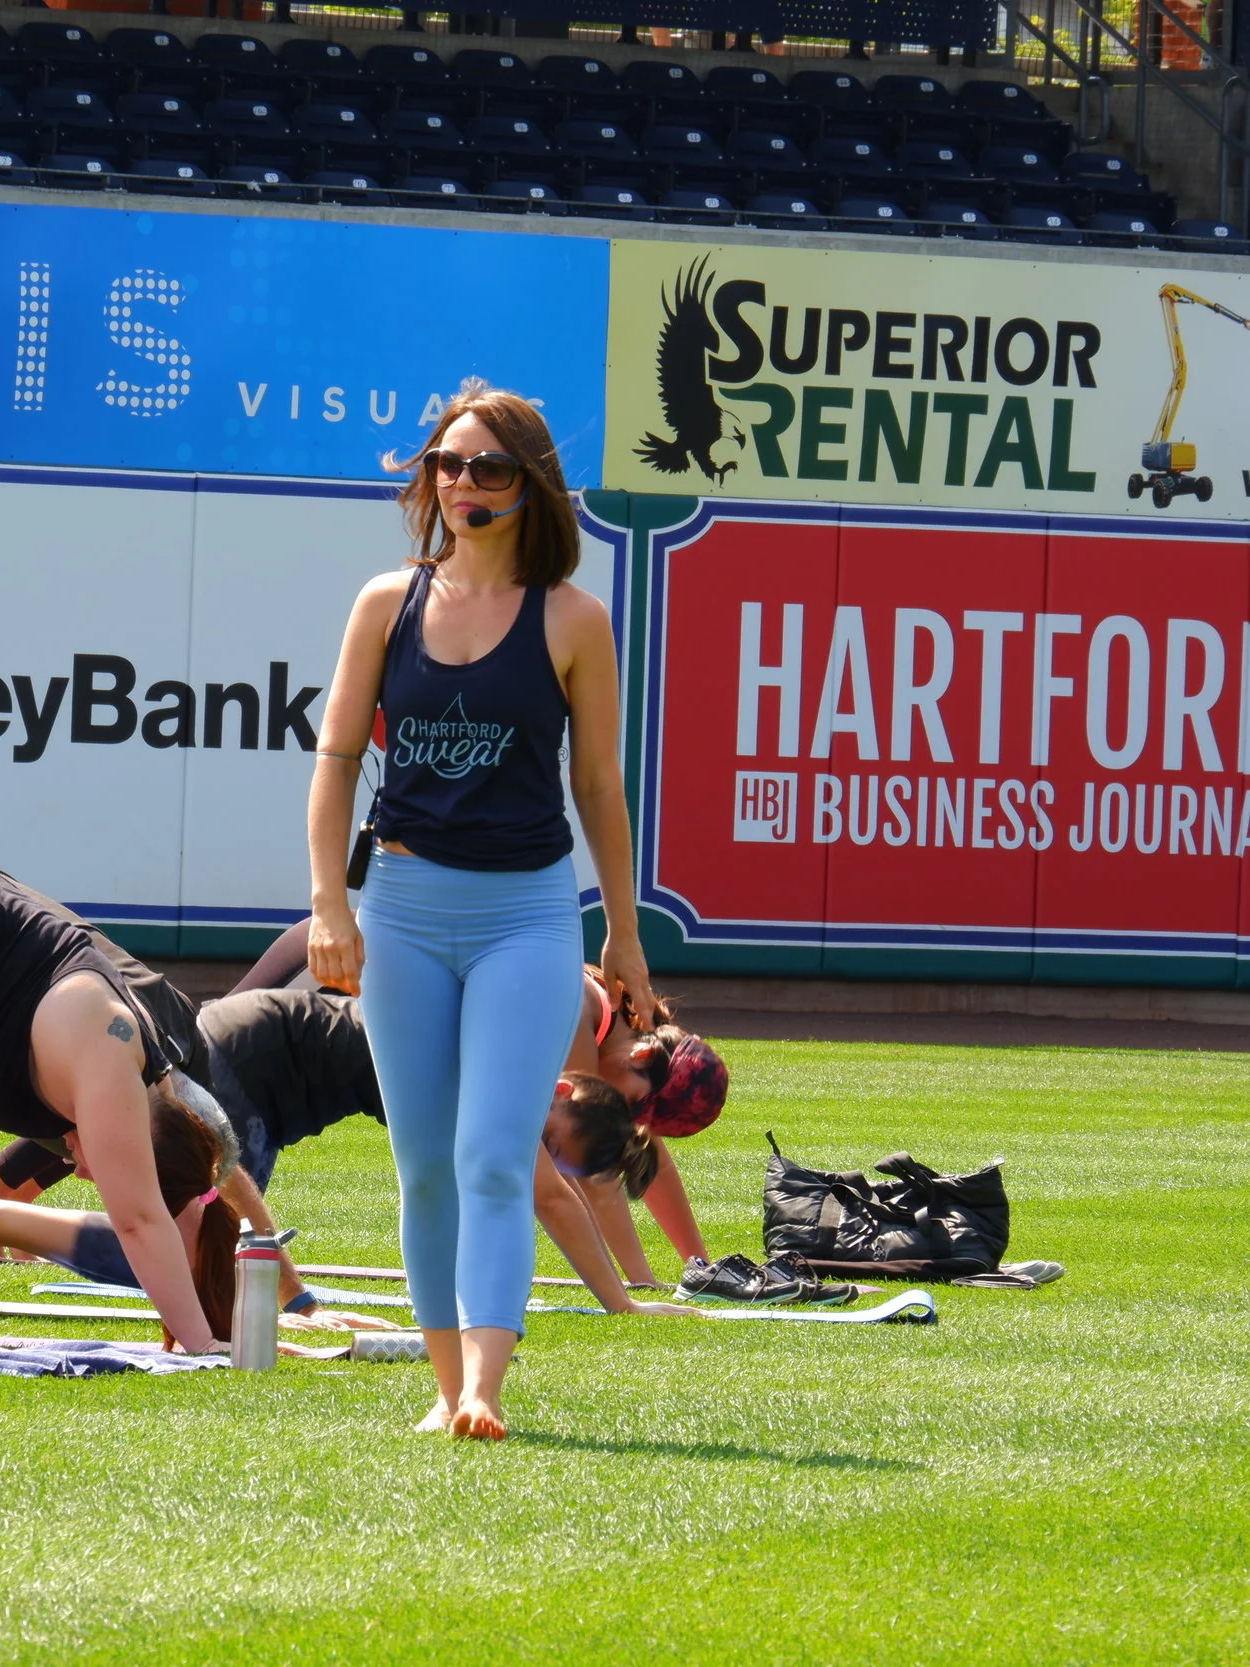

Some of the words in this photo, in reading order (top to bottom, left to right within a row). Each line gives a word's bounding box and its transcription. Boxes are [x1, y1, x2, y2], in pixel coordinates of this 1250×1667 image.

[708, 279, 1101, 389] SUPERIOR
[238, 381, 545, 427] VISUA
[718, 383, 1097, 493] RENTAL
[736, 602, 1250, 775] HARTFOR
[394, 716, 515, 768] Sweat
[418, 719, 501, 739] HARTFORD
[740, 777, 790, 841] HBJ
[813, 773, 1055, 850] BUSINESS
